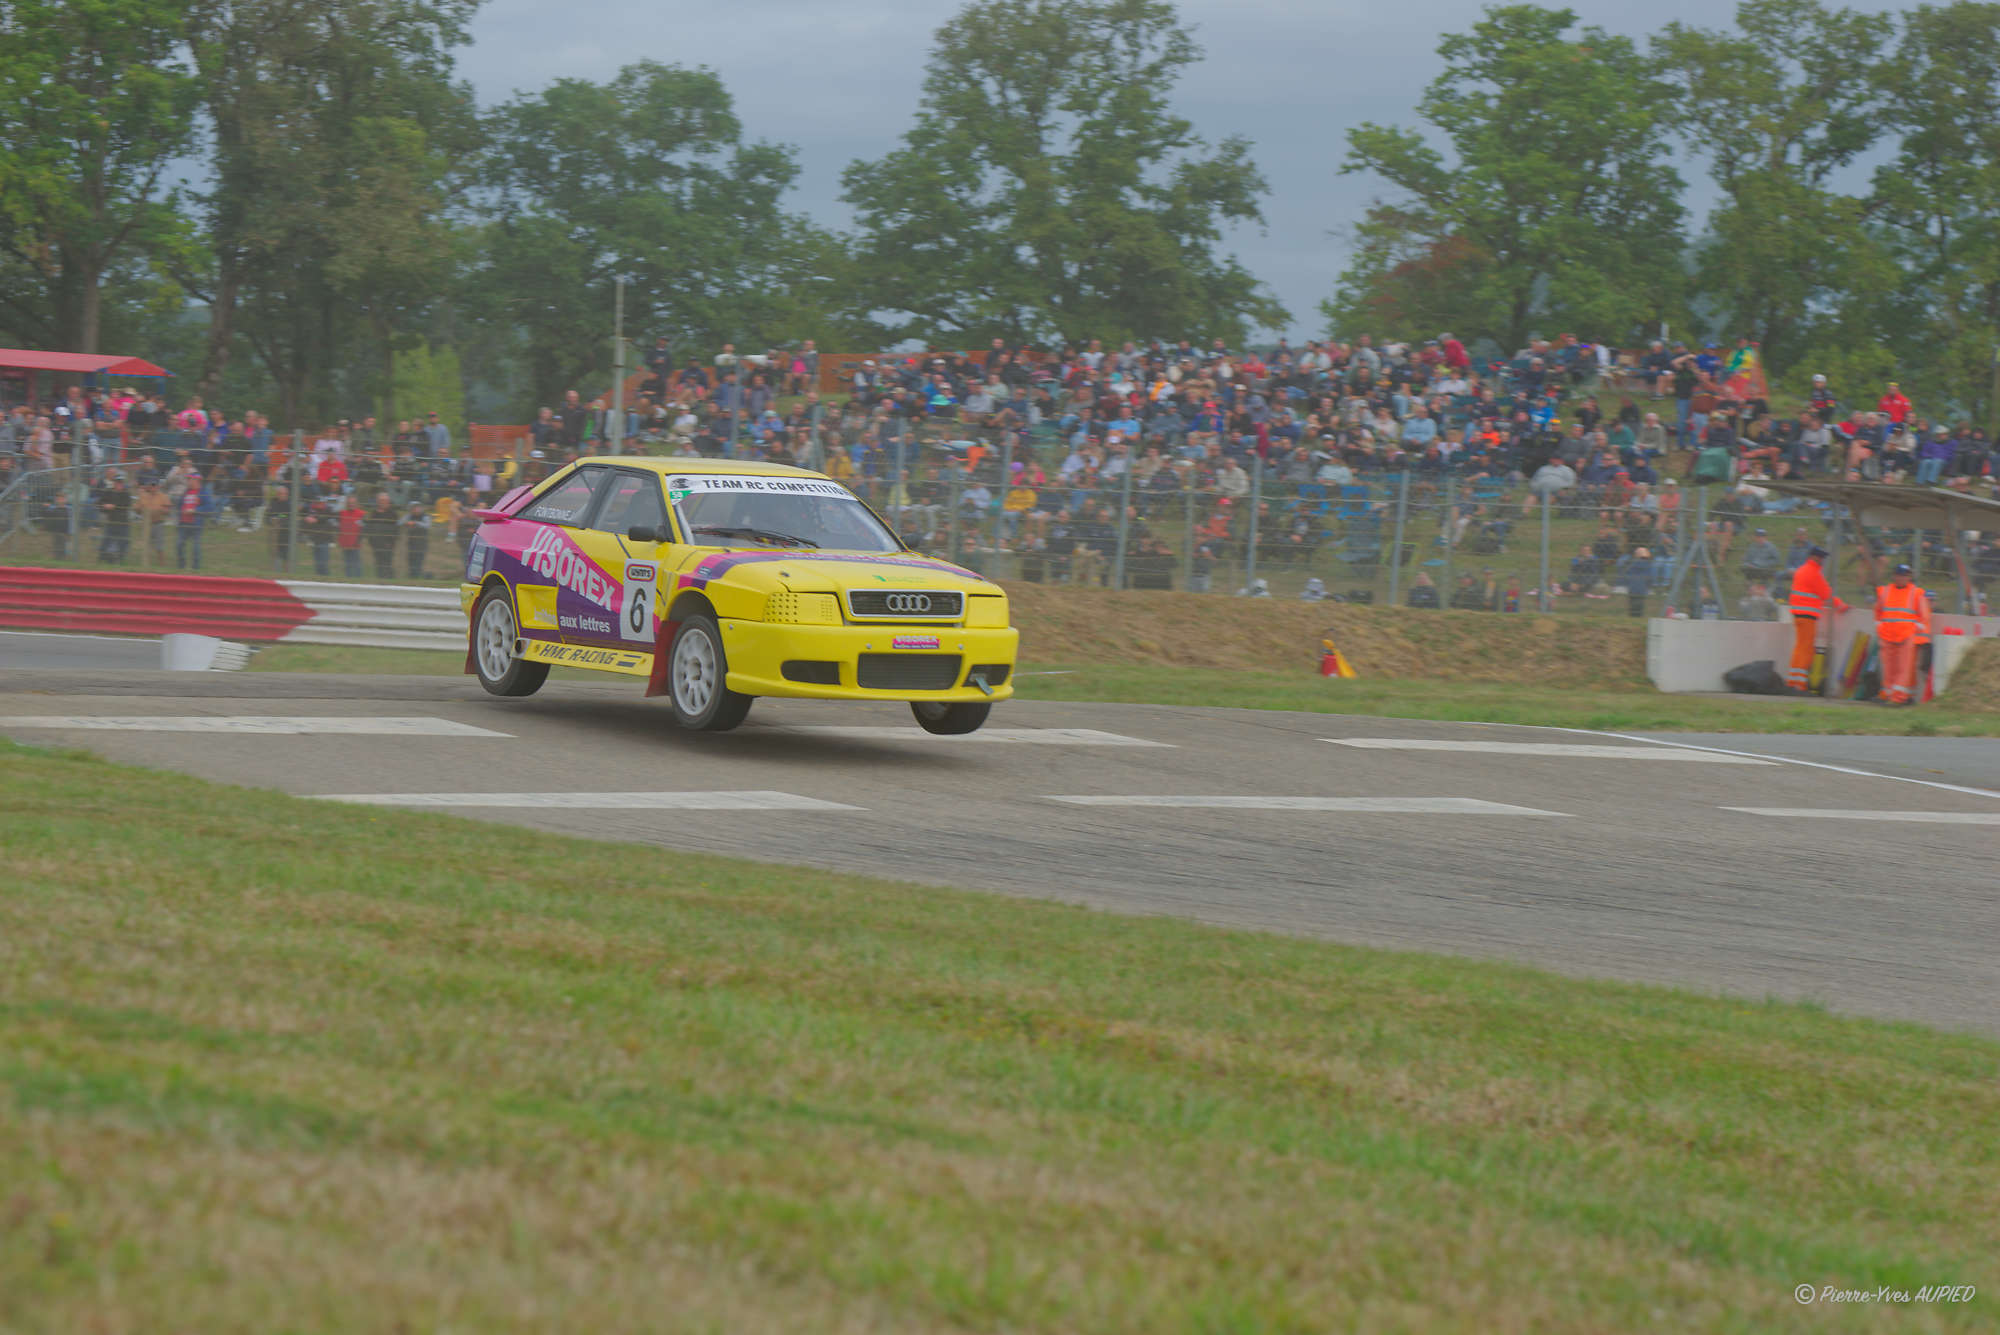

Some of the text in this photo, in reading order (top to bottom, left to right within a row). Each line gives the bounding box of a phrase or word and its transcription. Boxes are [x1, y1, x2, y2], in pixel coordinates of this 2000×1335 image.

[702, 479, 743, 489] TEAM
[747, 480, 764, 490] RC
[521, 525, 616, 611] VISOREX
[629, 588, 647, 633] 6
[560, 615, 577, 628] aux
[579, 615, 611, 632] lettres
[539, 644, 618, 665] HMC RACING
